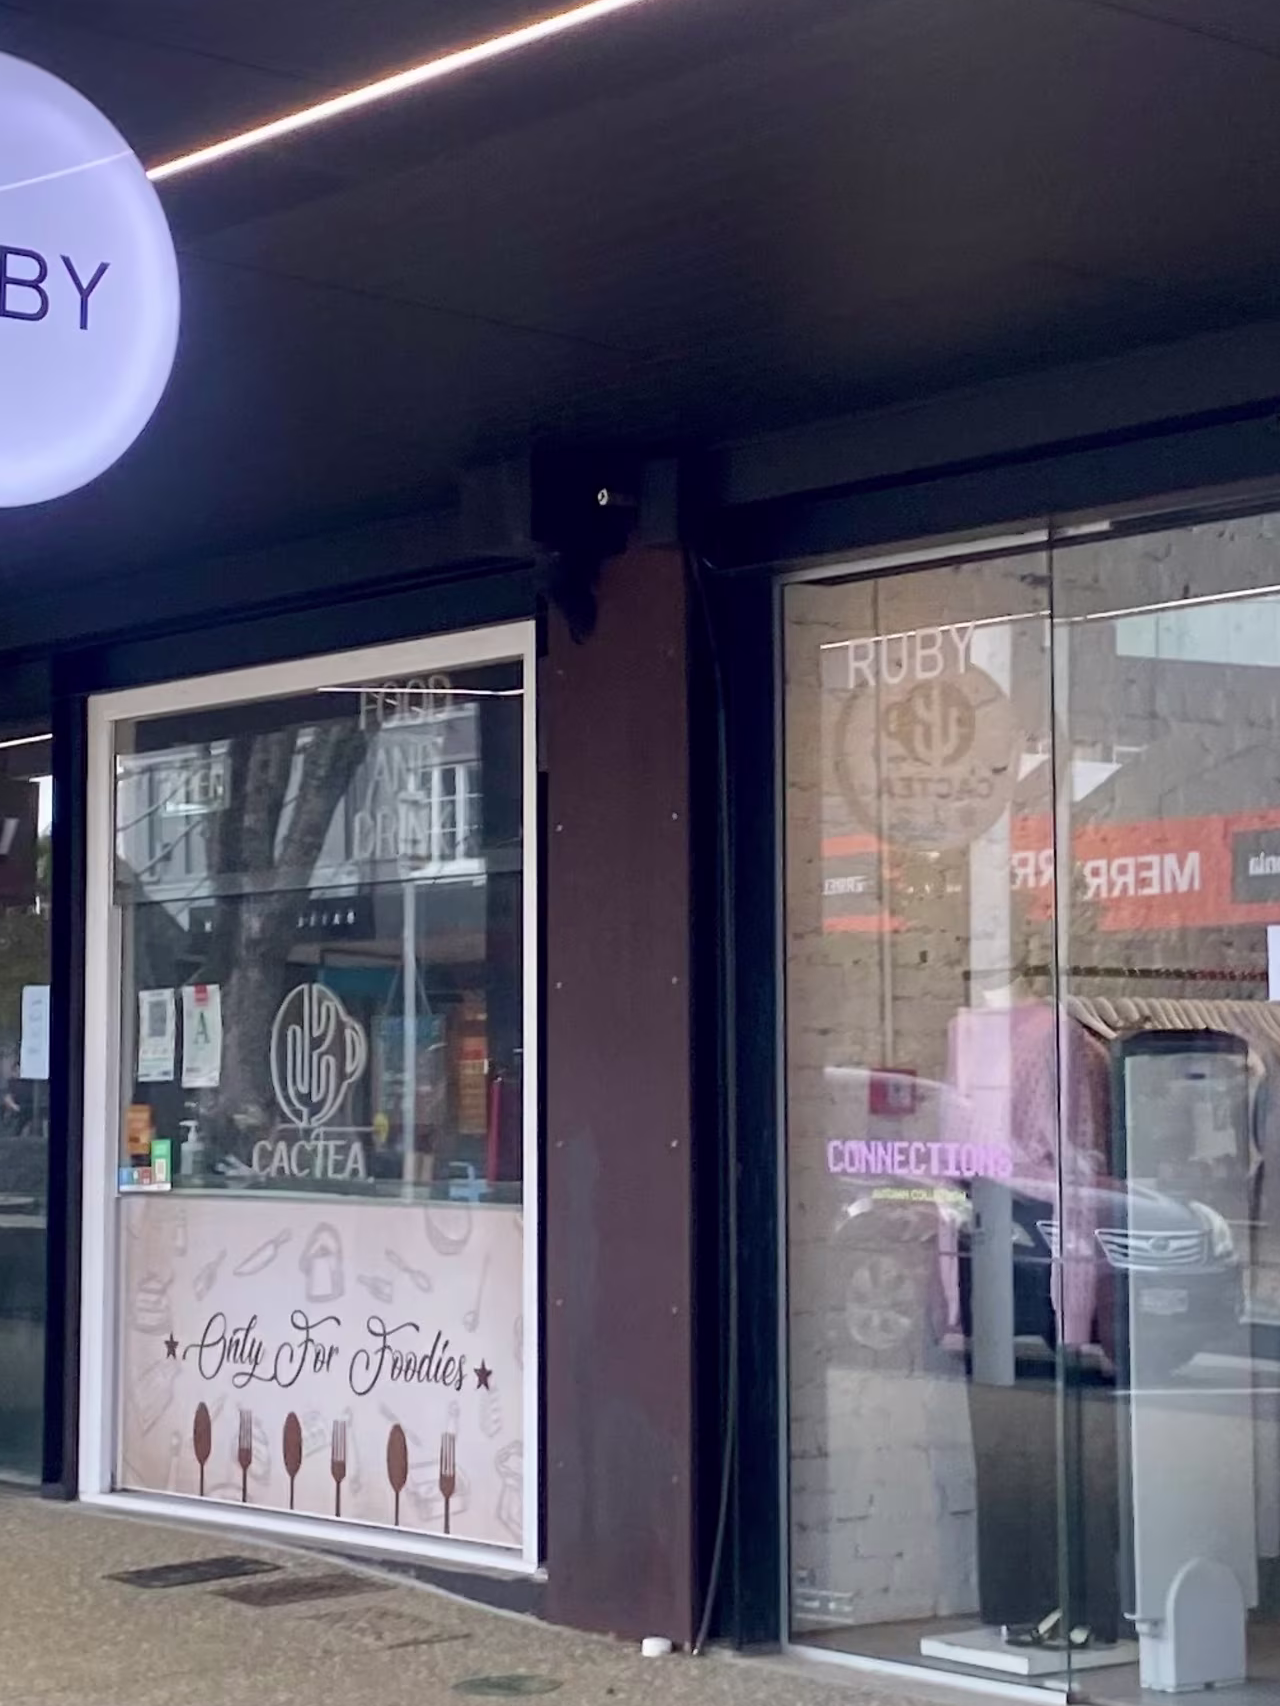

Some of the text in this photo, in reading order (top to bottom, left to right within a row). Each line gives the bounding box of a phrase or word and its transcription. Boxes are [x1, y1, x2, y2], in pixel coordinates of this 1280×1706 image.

[846, 624, 976, 689] RUBY
[192, 1011, 212, 1045] A
[251, 1138, 366, 1179] CACTEA
[827, 1140, 1014, 1179] CONNECTIONS
[183, 1309, 467, 1396] Only For Foodies
